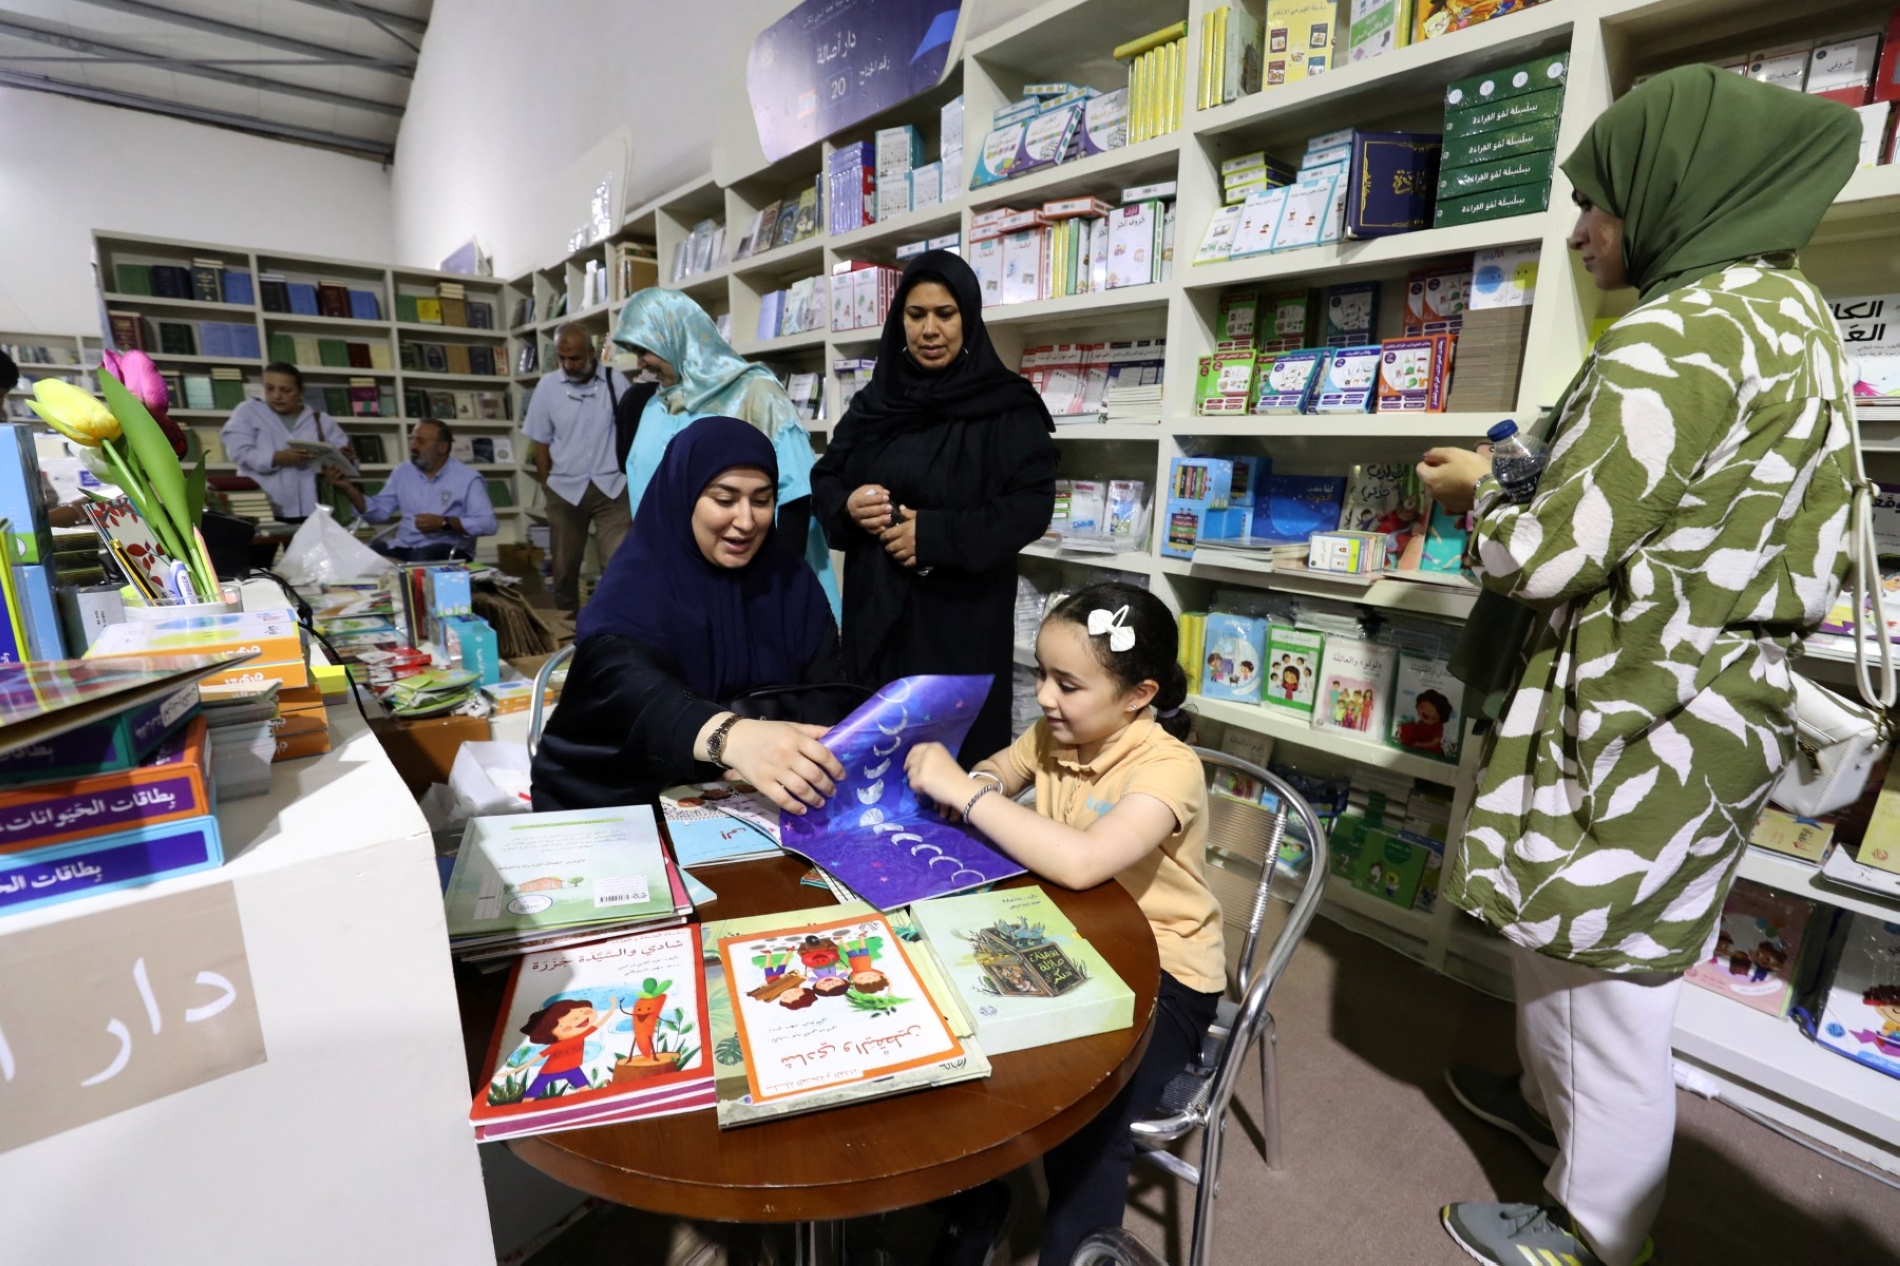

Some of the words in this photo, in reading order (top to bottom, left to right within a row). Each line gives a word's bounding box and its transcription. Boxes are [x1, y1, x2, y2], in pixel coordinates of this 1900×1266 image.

[816, 32, 841, 64] أصالة
[842, 30, 857, 56] دار
[831, 77, 846, 99] 20
[641, 939, 683, 957] شادي
[80, 957, 236, 1087] دار
[781, 1042, 836, 1069] شادي
